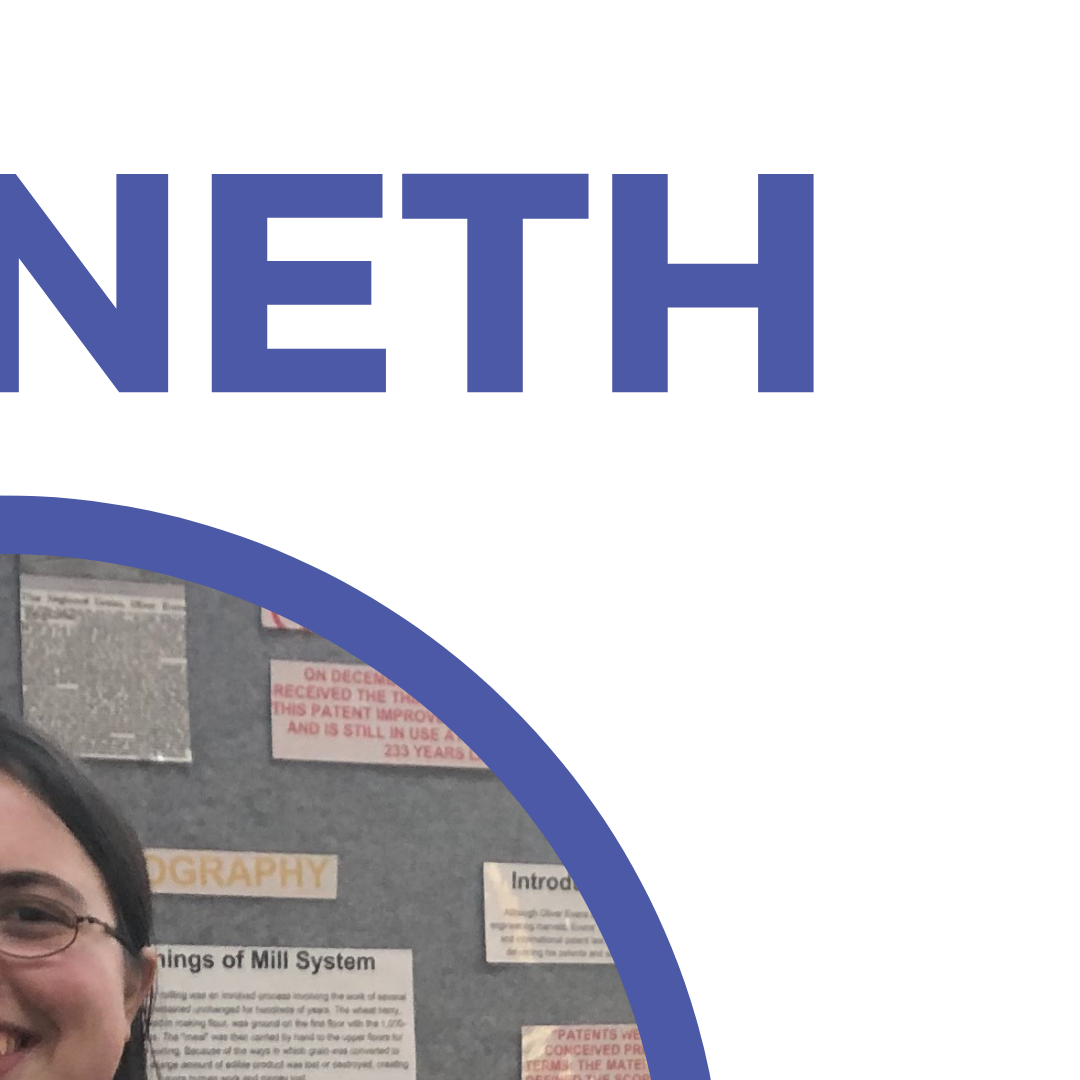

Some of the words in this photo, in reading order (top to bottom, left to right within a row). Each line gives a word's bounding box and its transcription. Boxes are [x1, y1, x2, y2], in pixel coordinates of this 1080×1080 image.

[304, 668, 325, 681] ON
[274, 684, 351, 701] RECEIVED
[358, 689, 386, 703] THE
[273, 702, 306, 716] THIS
[312, 704, 372, 720] PATENT
[377, 709, 442, 724] IMPROV
[288, 720, 319, 735] AND
[325, 723, 338, 736] IS
[344, 724, 384, 739] STILL
[390, 727, 404, 739] IN
[409, 728, 439, 740] USE
[384, 744, 409, 757] 233
[415, 745, 464, 760] YEARS
[222, 949, 245, 969] of
[252, 949, 287, 970] Mill
[296, 950, 376, 975] System
[545, 1045, 620, 1055] CONCEIVED
[578, 1060, 601, 1070] THE
[607, 1060, 647, 1070] MATE
